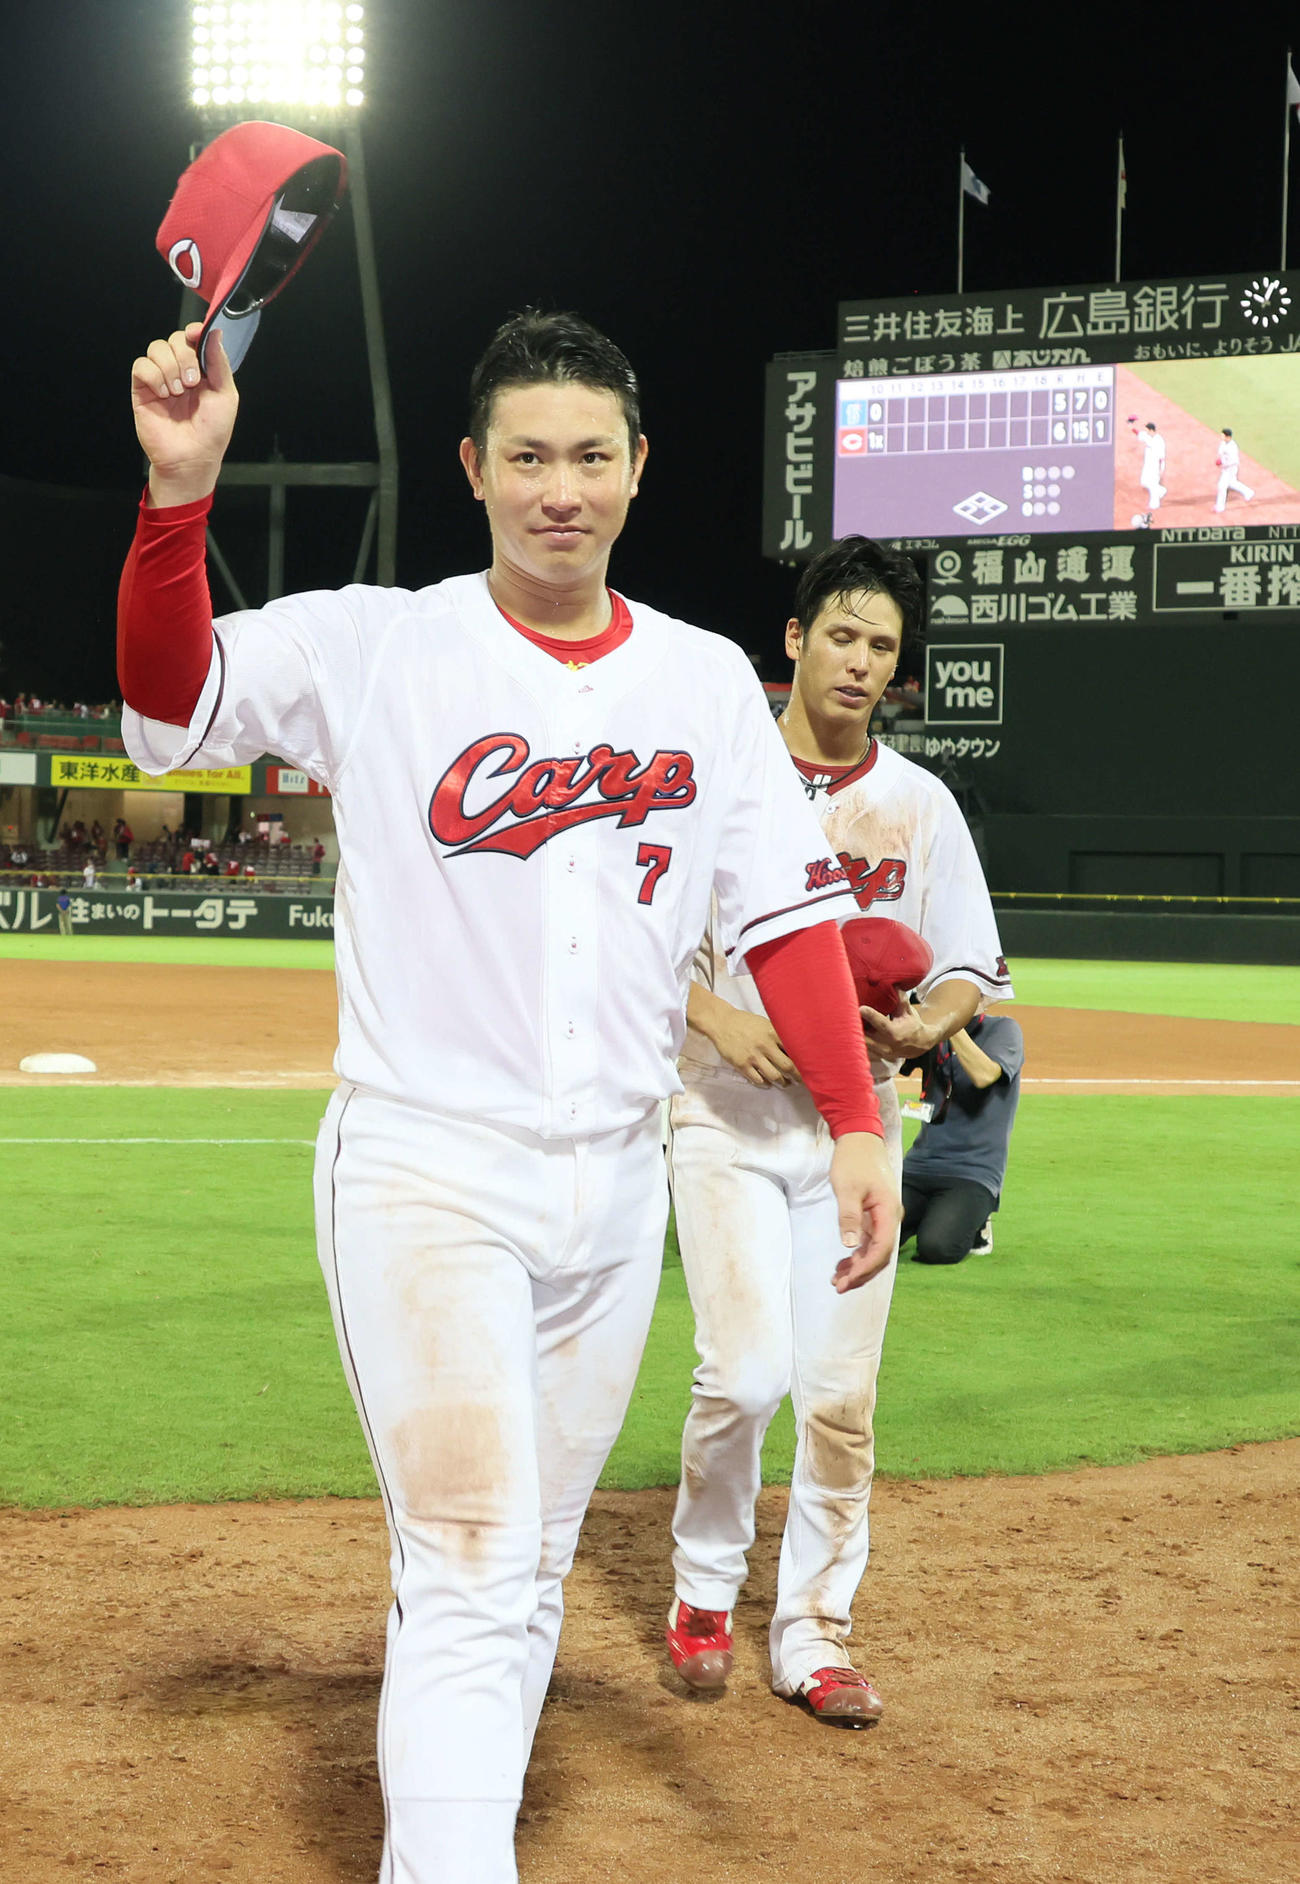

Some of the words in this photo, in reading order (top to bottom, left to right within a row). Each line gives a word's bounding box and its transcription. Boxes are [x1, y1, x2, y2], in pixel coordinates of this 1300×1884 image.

[844, 304, 1025, 342] 三井住友海上
[1039, 283, 1230, 339] 広島銀行
[843, 351, 982, 378] 焙煎ごぼう茶
[869, 402, 882, 422] 0
[1054, 393, 1066, 412] 5
[1074, 392, 1087, 410] 7
[1094, 390, 1108, 410] 0
[1053, 422, 1066, 441] 6
[1072, 421, 1089, 440] 15
[1095, 420, 1105, 439] 1
[780, 371, 817, 550] アサヒビール
[1022, 484, 1033, 499] S
[971, 546, 1136, 585] 福山通運
[1230, 544, 1295, 563] KIRIN
[1177, 564, 1300, 606] 一番搾
[971, 591, 1138, 624] 西川ゴム工業
[935, 661, 992, 689] you
[945, 686, 995, 708] me
[925, 737, 1001, 758] ゆめタウン
[59, 761, 141, 784] 東洋水産
[428, 732, 697, 861] Carp
[635, 842, 672, 906] 7
